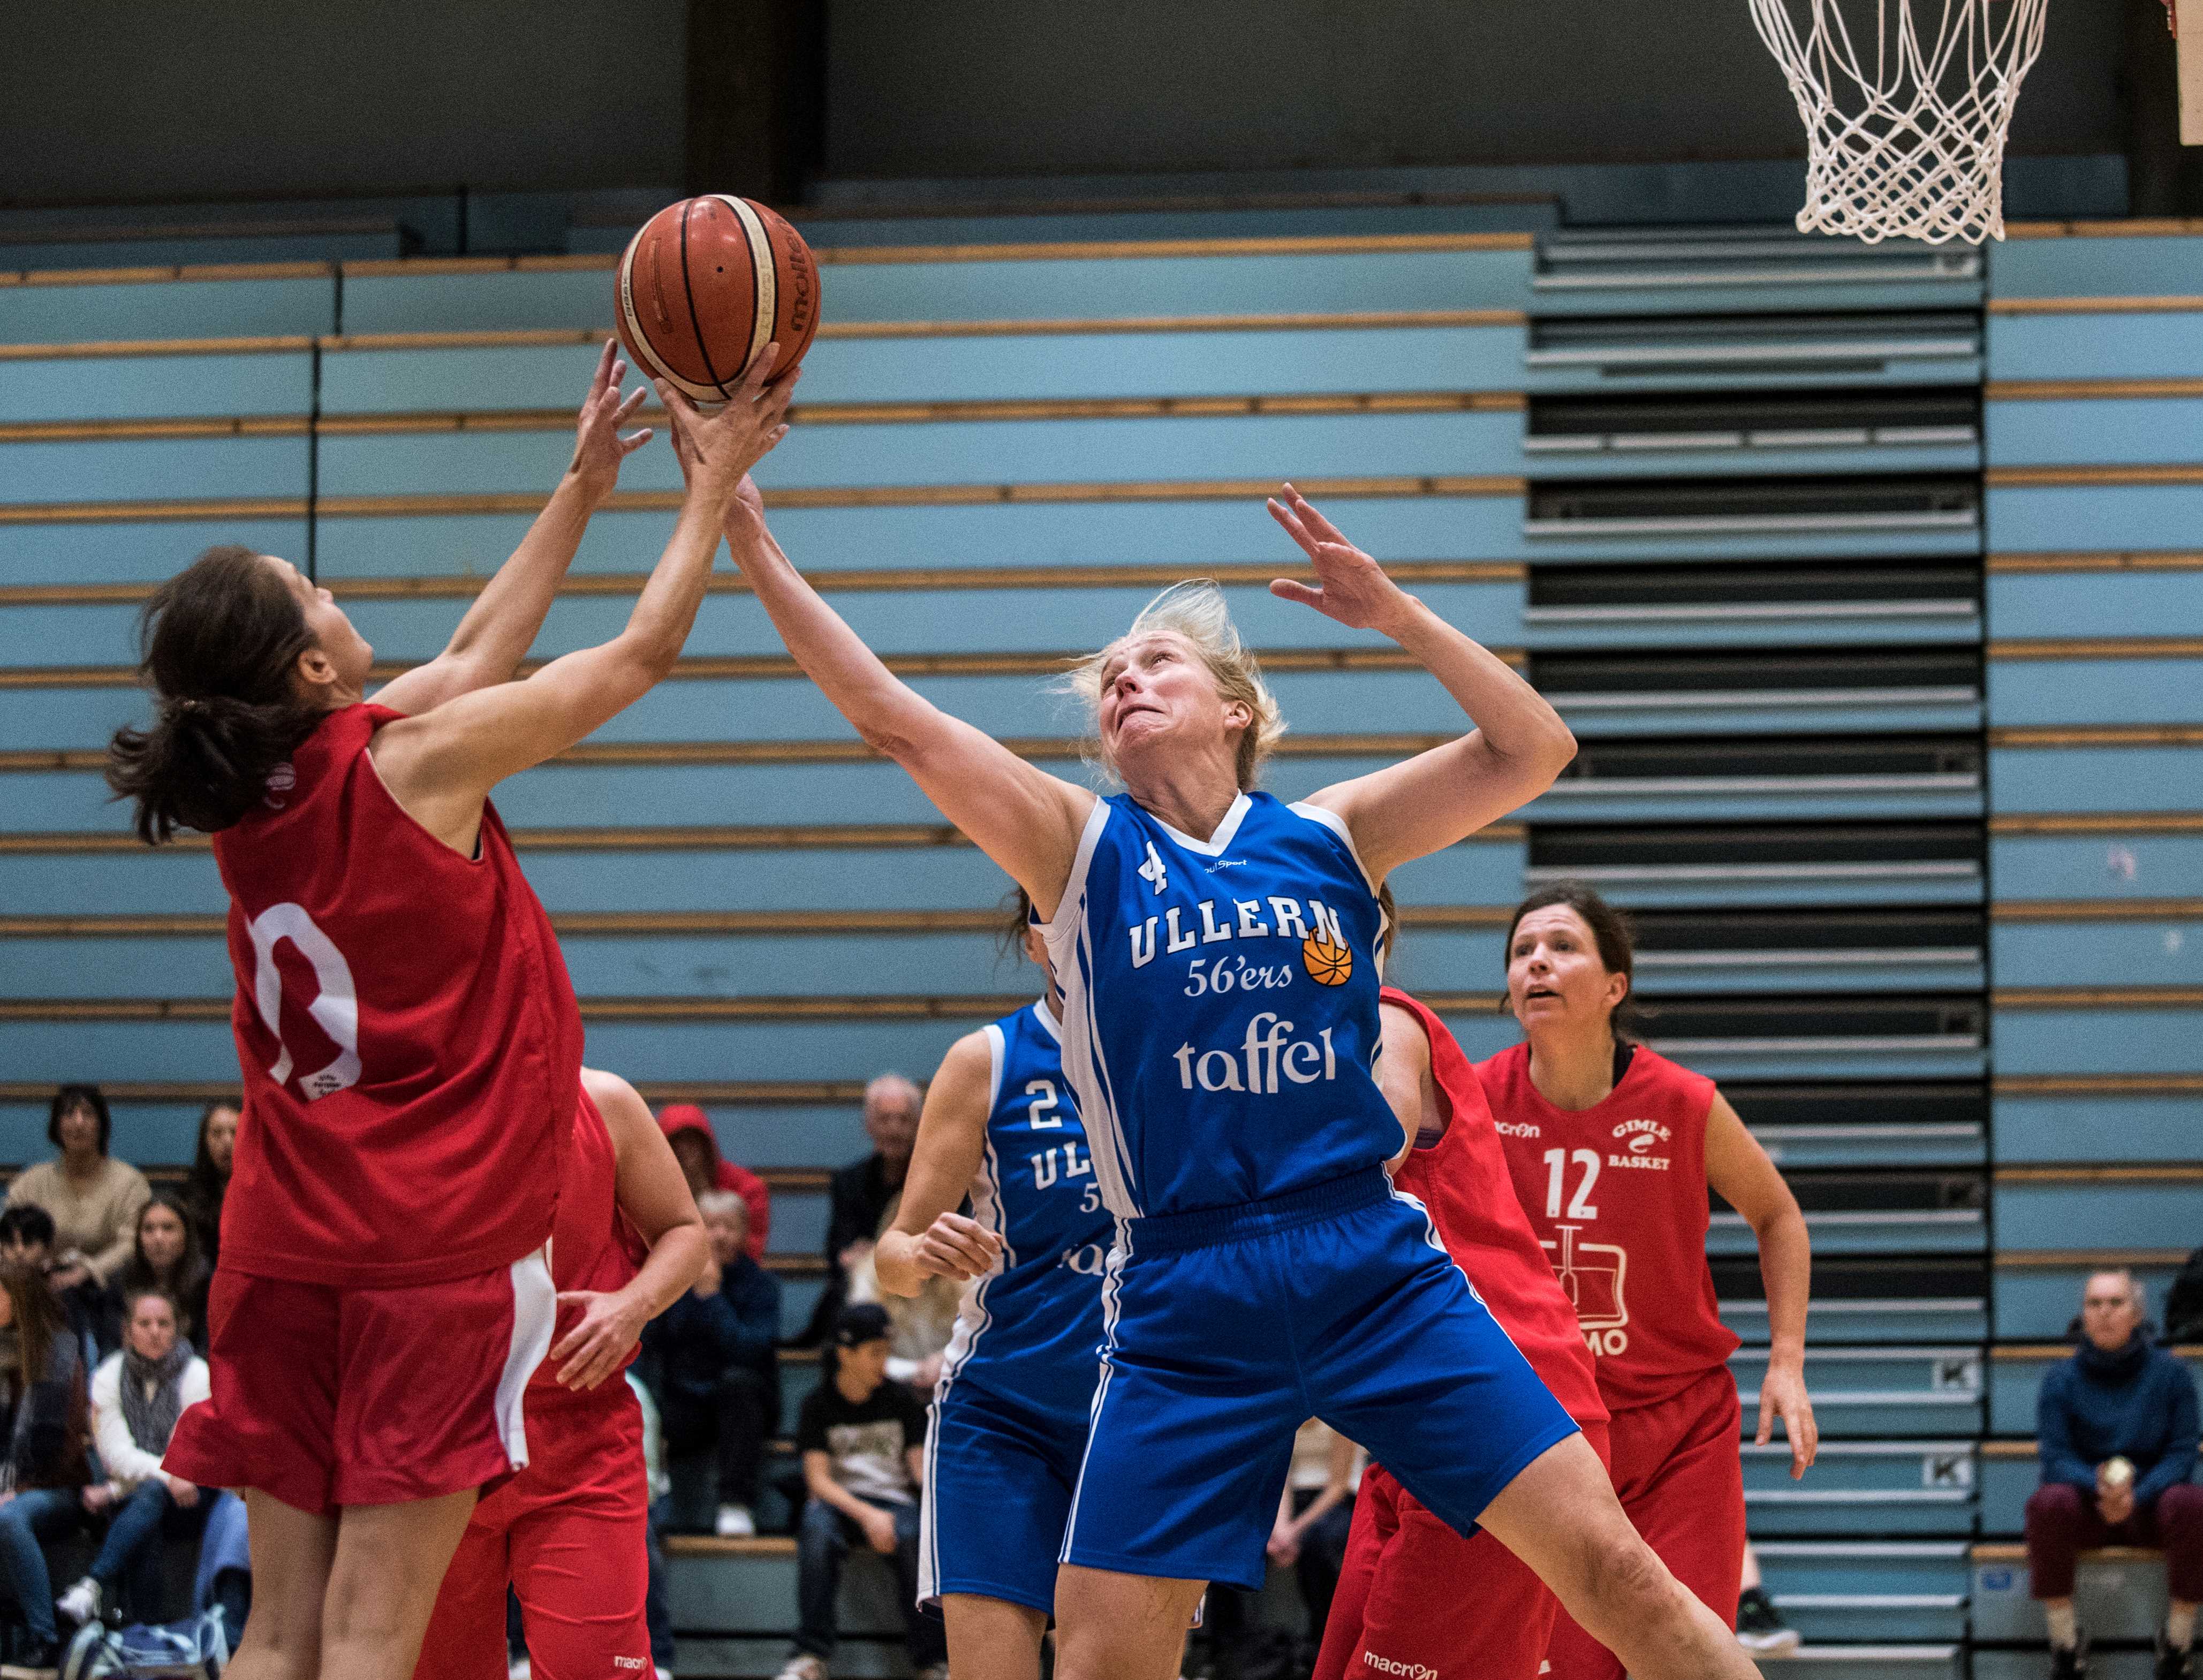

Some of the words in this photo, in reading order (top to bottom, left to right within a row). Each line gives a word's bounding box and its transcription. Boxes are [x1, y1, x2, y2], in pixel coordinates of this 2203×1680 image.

[1138, 841, 1167, 895] 4
[1129, 896, 1347, 969] ULLERN
[1184, 955, 1293, 997] 56'ers
[1172, 1013, 1336, 1094] taffel
[1025, 1080, 1063, 1130] 2
[1612, 1119, 1671, 1140] GIMLE
[1544, 1148, 1601, 1220] 12
[1608, 1154, 1670, 1170] BASKET
[1364, 1651, 1439, 1680] macron
